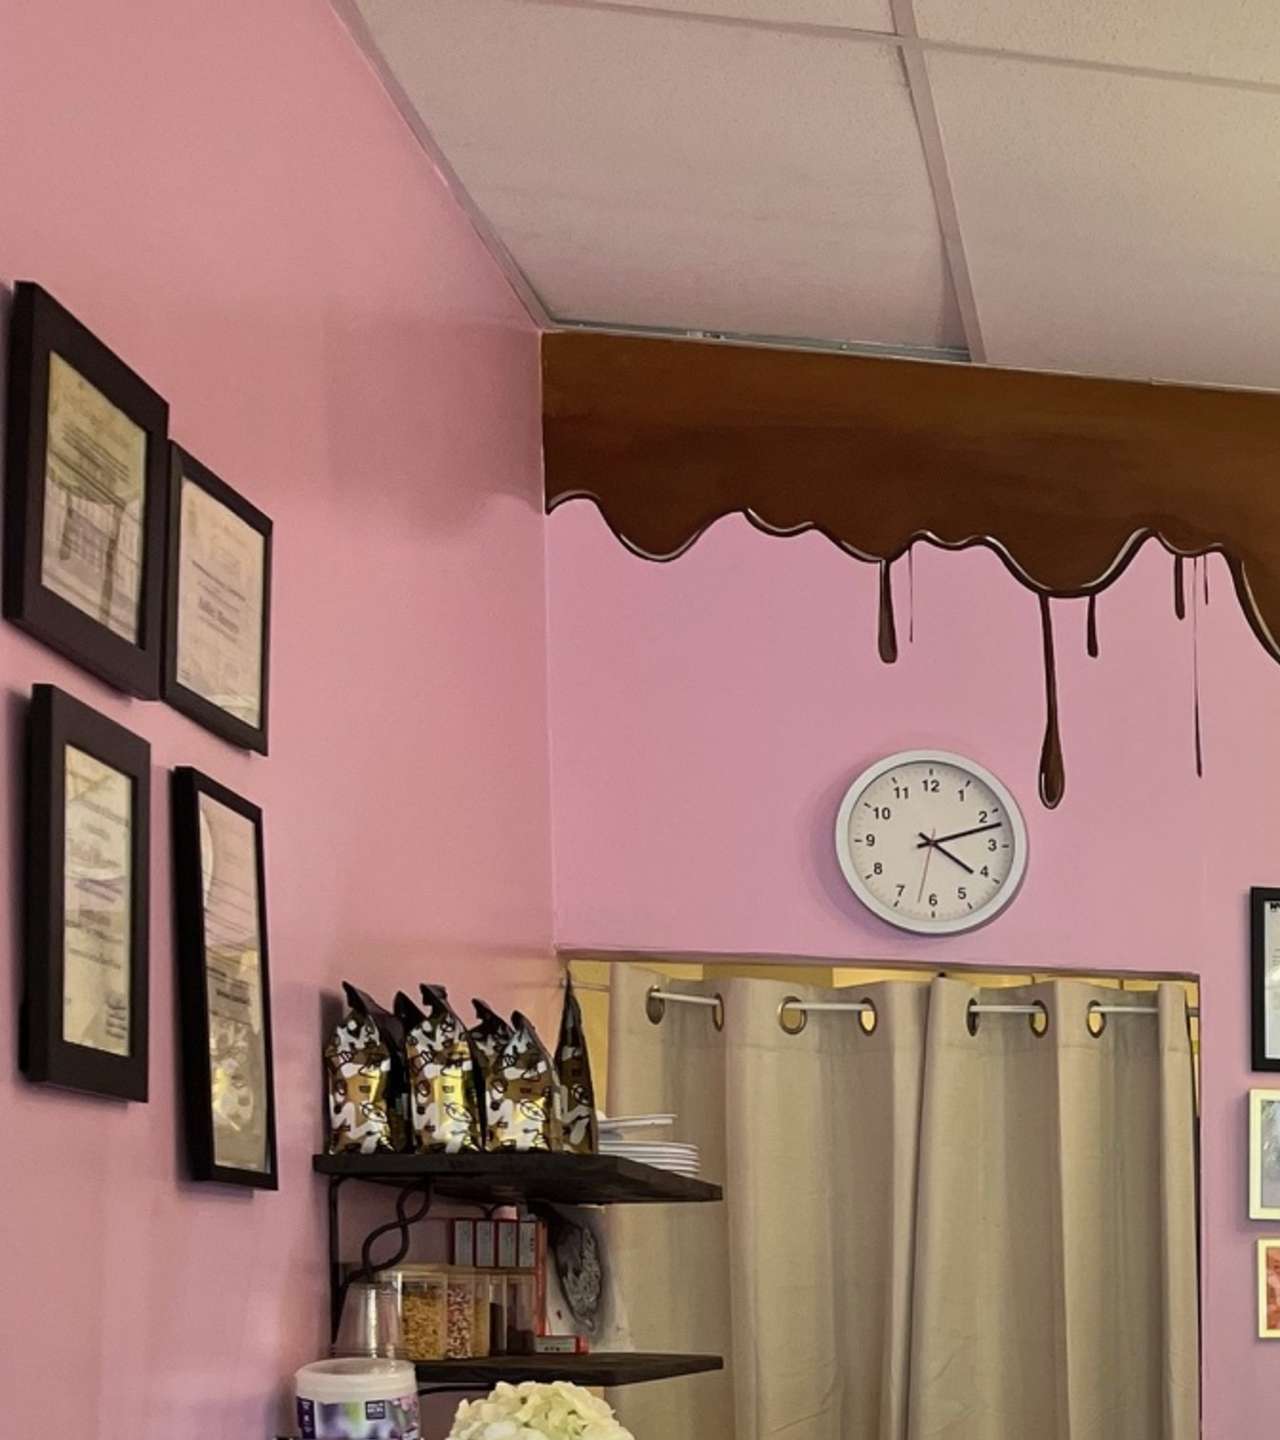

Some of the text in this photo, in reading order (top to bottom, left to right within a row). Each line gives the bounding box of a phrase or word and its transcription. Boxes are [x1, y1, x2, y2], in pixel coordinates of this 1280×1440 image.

[922, 779, 940, 793] 12
[894, 787, 909, 800] 11
[958, 789, 965, 801] 1
[873, 807, 890, 819] 10
[978, 811, 988, 823] 2
[866, 834, 875, 847] 9
[988, 839, 997, 851] 3
[874, 862, 883, 875] 8
[980, 866, 989, 877] 4
[896, 885, 905, 897] 7
[957, 887, 967, 900] 5
[929, 894, 938, 906] 6
